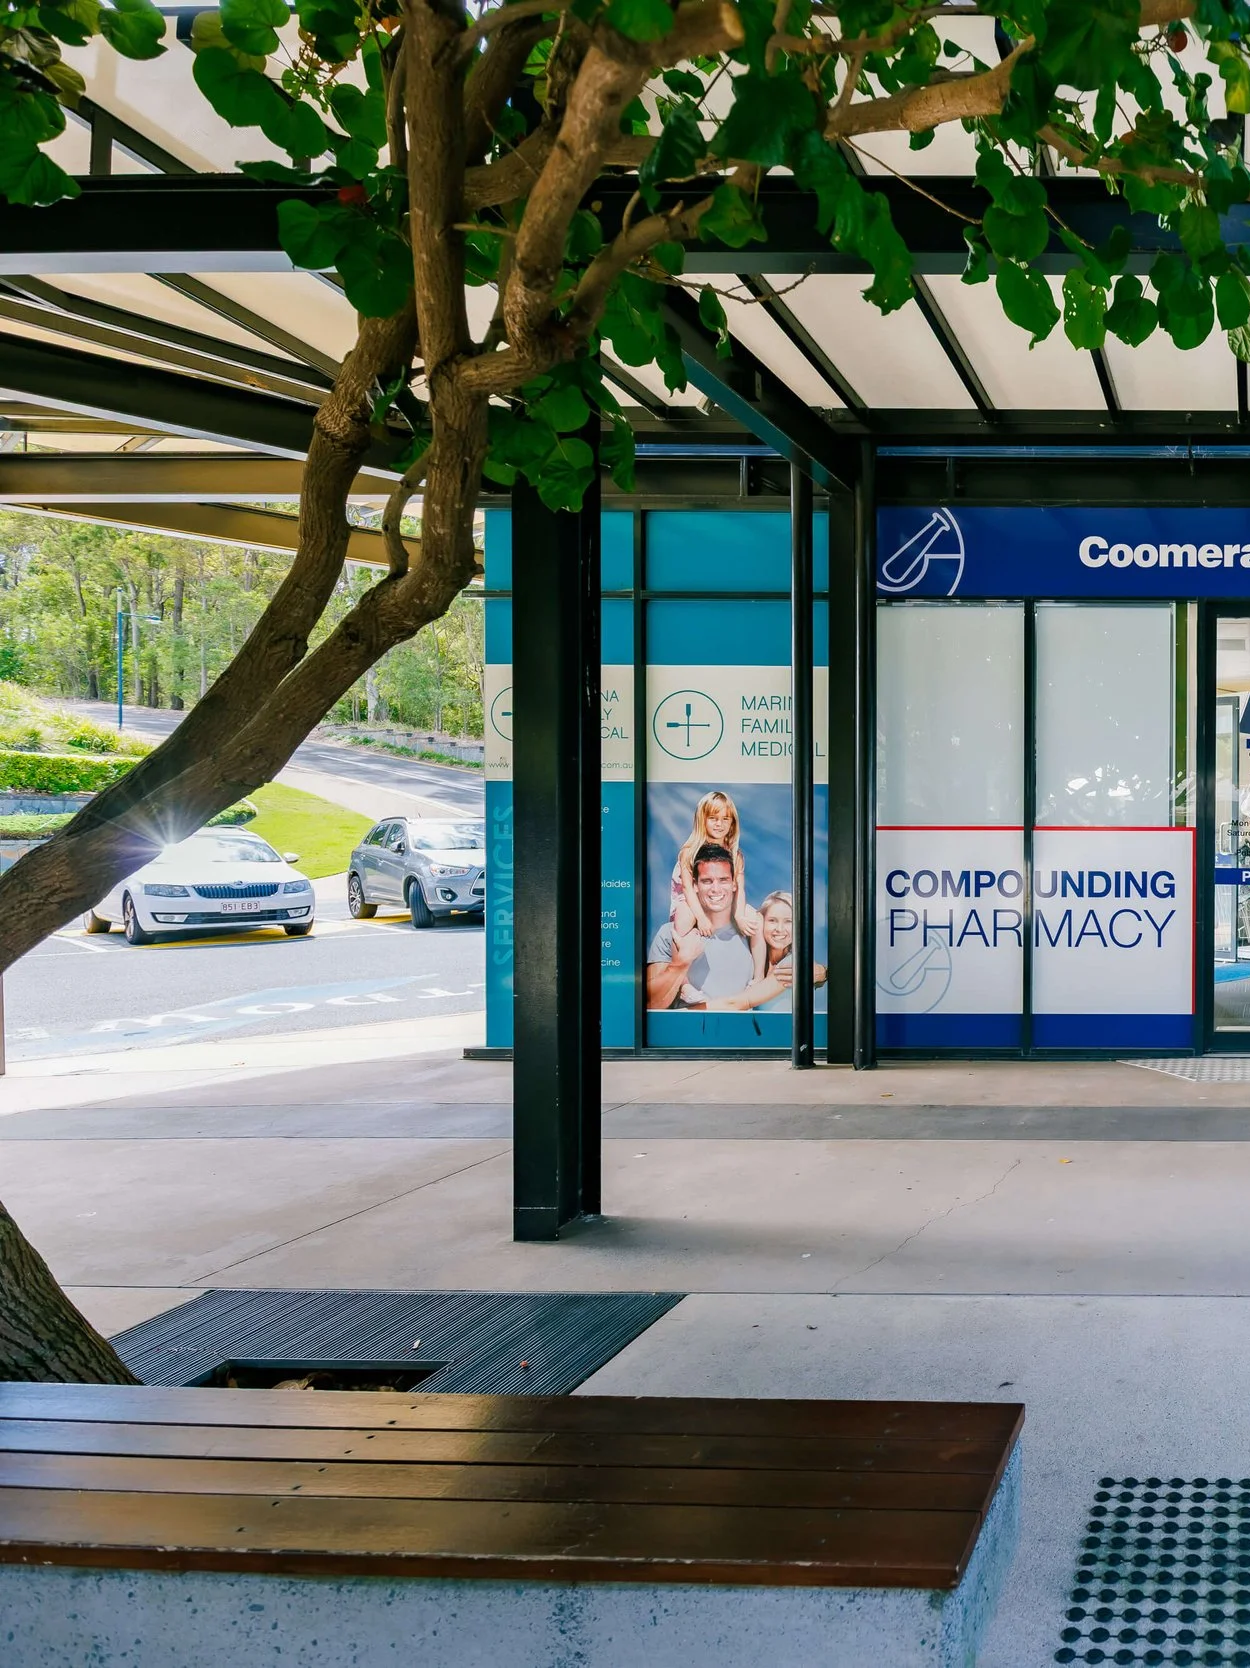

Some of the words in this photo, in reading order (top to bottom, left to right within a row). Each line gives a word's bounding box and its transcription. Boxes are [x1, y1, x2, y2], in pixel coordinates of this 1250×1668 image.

[741, 695, 792, 711] MARI
[741, 718, 792, 733] FAMIL
[741, 741, 826, 756] MEDIL
[885, 869, 1177, 899] COMPOUNDING
[889, 908, 1177, 949] PHARMACY
